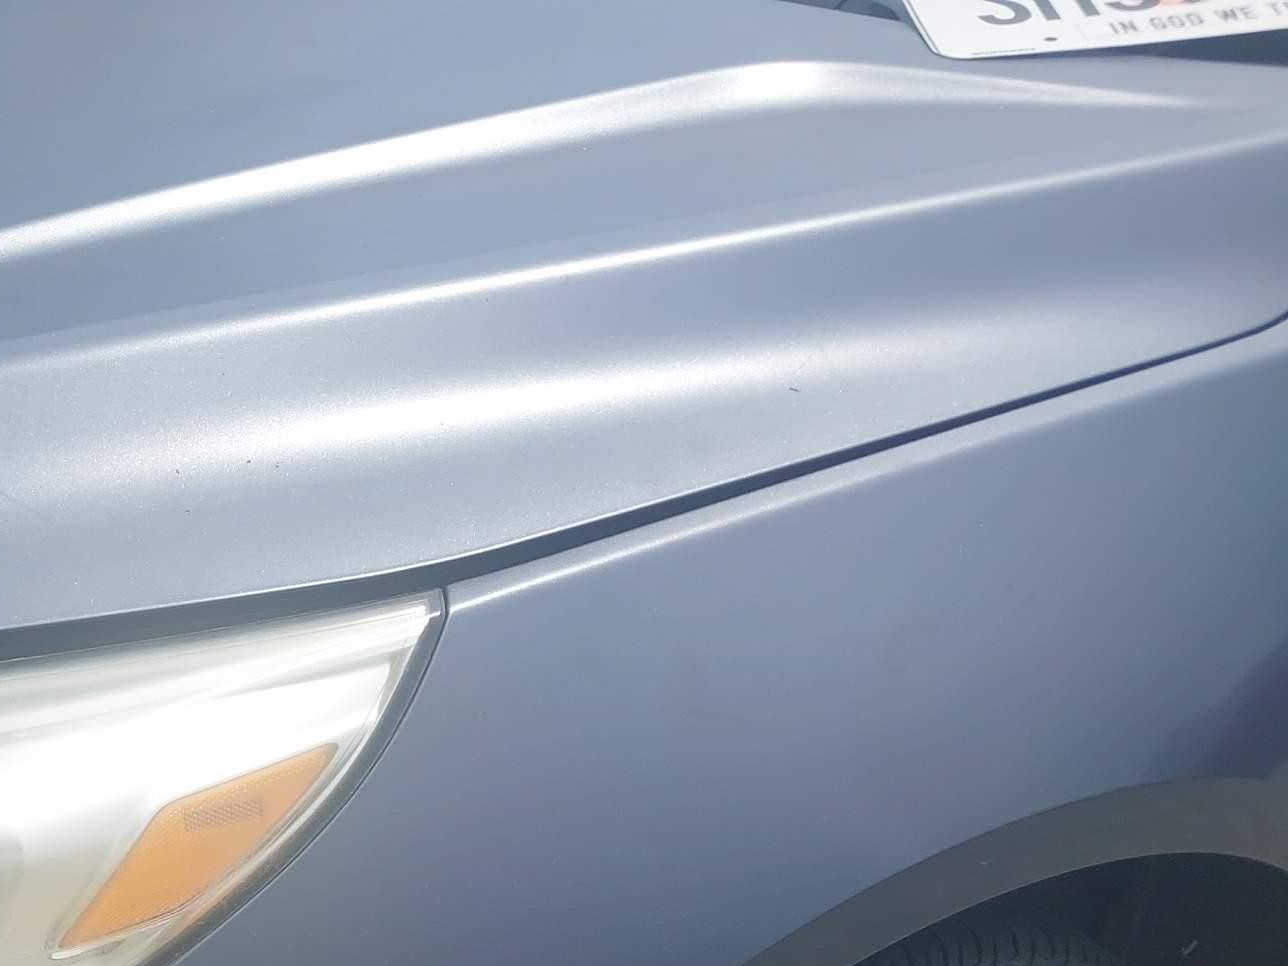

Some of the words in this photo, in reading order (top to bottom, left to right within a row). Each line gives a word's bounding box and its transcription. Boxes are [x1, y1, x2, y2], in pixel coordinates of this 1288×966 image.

[1109, 19, 1139, 35] IN
[1149, 12, 1204, 31] GOD
[1213, 6, 1257, 23] WE
